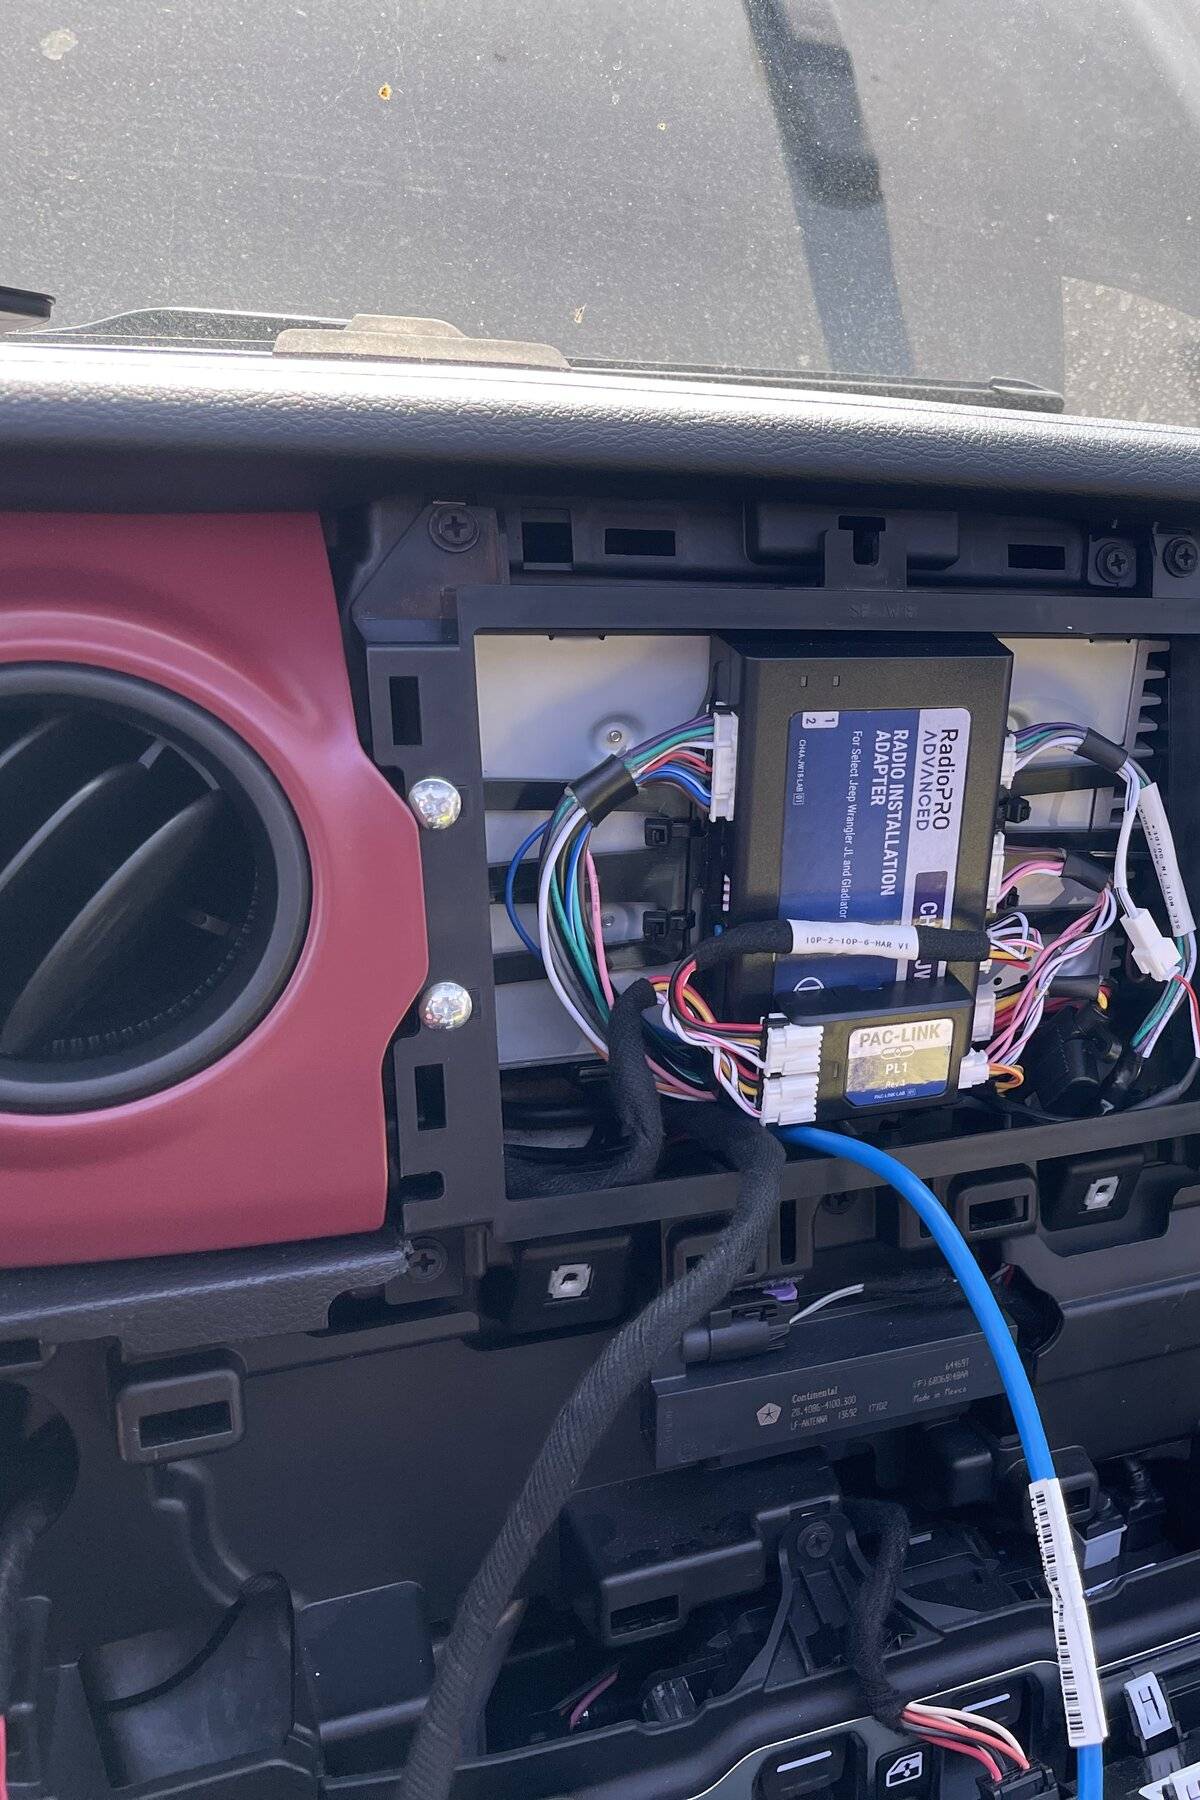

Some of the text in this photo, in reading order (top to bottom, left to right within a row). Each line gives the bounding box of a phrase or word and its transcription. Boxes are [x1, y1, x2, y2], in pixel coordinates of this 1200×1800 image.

[805, 717, 817, 725] 2
[824, 716, 836, 724] 1
[871, 730, 891, 807] ADAPTER
[915, 730, 937, 831] ADVANCED
[932, 728, 959, 830] RadioPRO
[839, 730, 863, 919] For Select Jeep Wrangler JL and Gladiator
[880, 729, 909, 896] RADIO INSTALLATION
[885, 1063, 908, 1075] PL1
[792, 1386, 838, 1403] Continental
